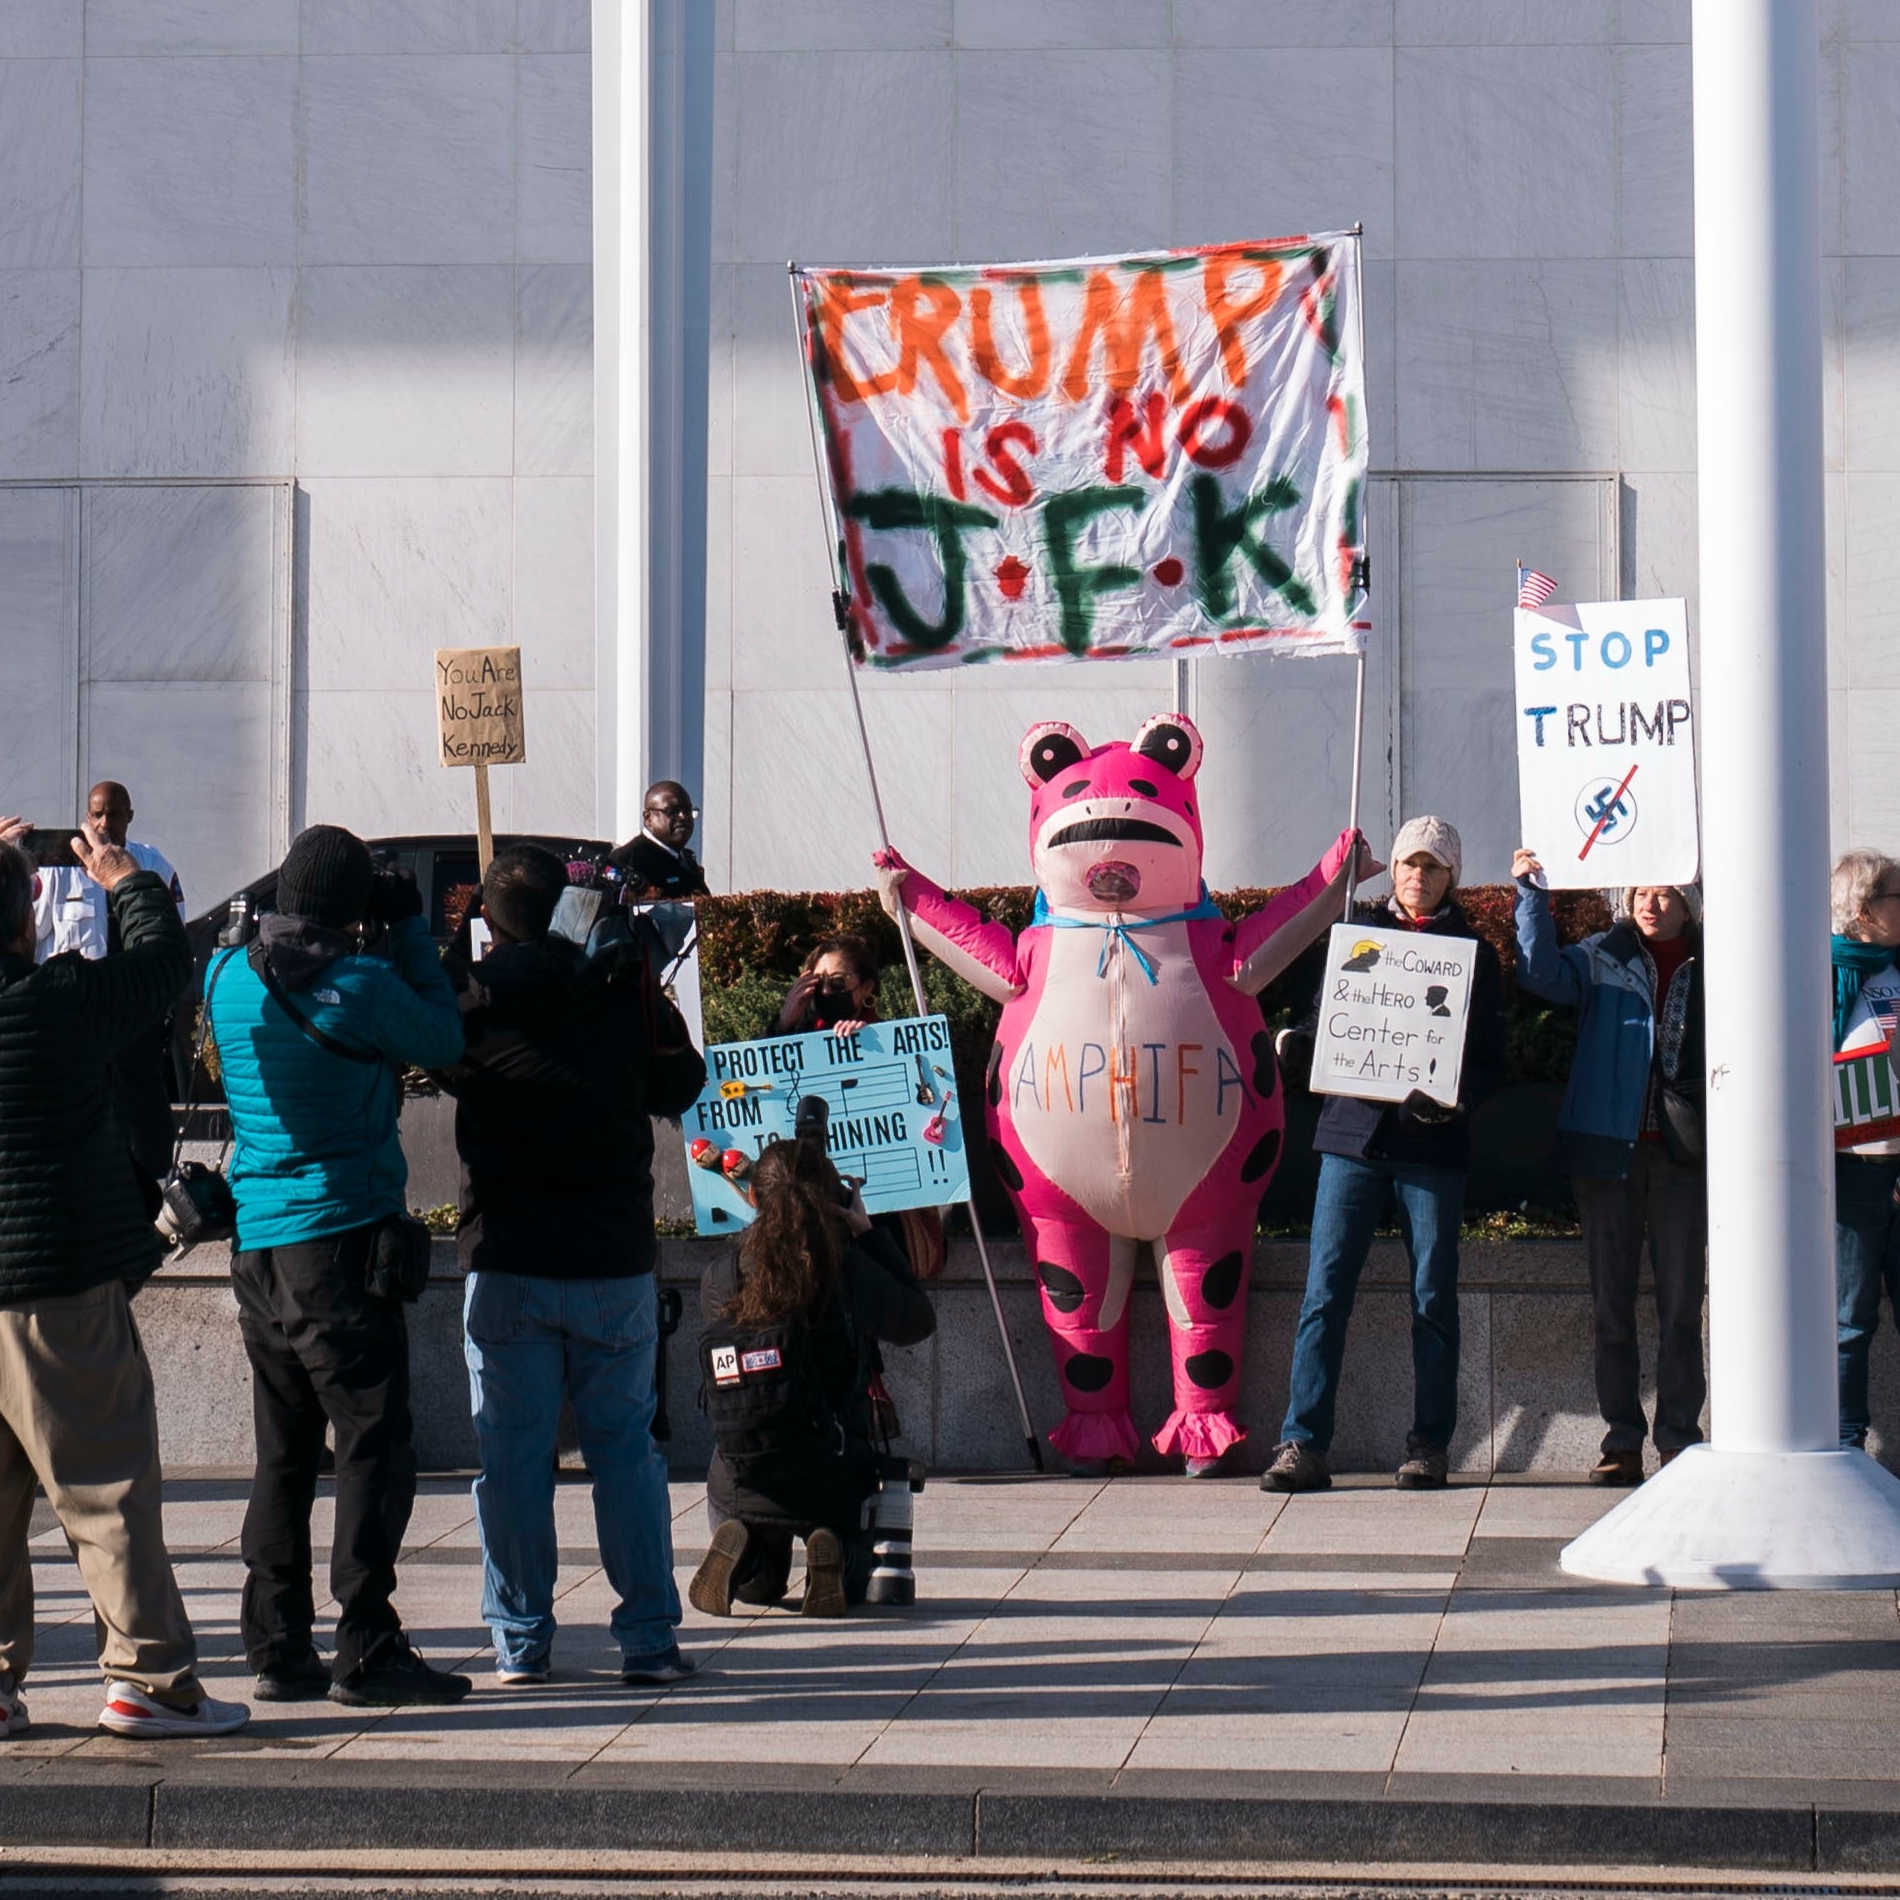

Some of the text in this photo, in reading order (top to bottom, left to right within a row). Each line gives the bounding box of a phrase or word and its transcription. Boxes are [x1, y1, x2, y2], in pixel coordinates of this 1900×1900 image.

[821, 252, 1283, 423] TRUMP
[943, 390, 1252, 508] IS NO
[1530, 628, 1671, 671] STOP
[442, 691, 516, 721] No Jack
[1523, 699, 1691, 748] TRUMP
[443, 732, 518, 759] Kennedy
[1333, 979, 1349, 1002] &
[1328, 1012, 1445, 1047] Center for
[713, 1020, 949, 1080] PROTECT THE ARTS!
[1333, 1052, 1355, 1068] the
[1015, 1042, 1257, 1125] AMPHIFA
[696, 1096, 763, 1132] FROM
[826, 1112, 907, 1152] HINING
[716, 1354, 735, 1371] AP
